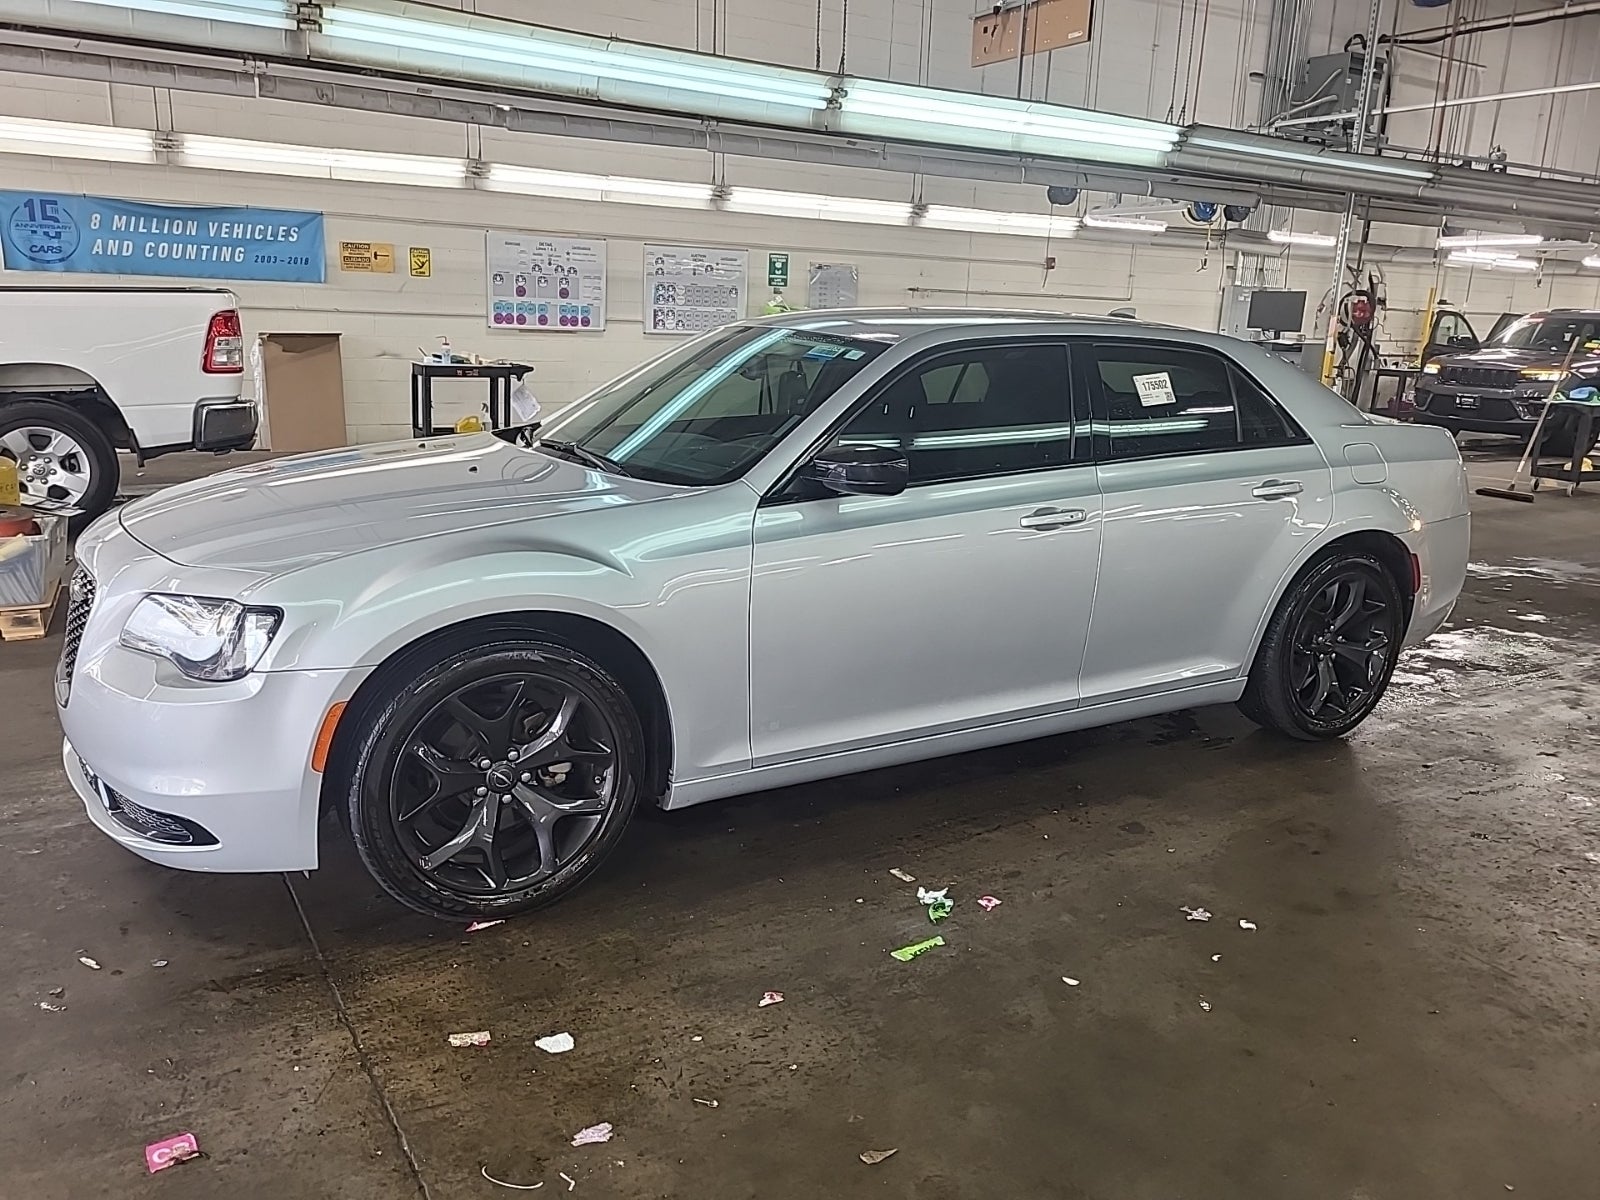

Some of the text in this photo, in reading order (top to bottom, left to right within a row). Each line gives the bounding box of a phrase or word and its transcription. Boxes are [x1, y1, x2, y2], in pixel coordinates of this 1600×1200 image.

[14, 222, 72, 231] ANNIVERSARY
[90, 213, 300, 242] 8 MILLION VEHICLES
[29, 244, 63, 254] CARS
[91, 238, 246, 263] AND COUNTING
[1142, 379, 1168, 391] 175502
